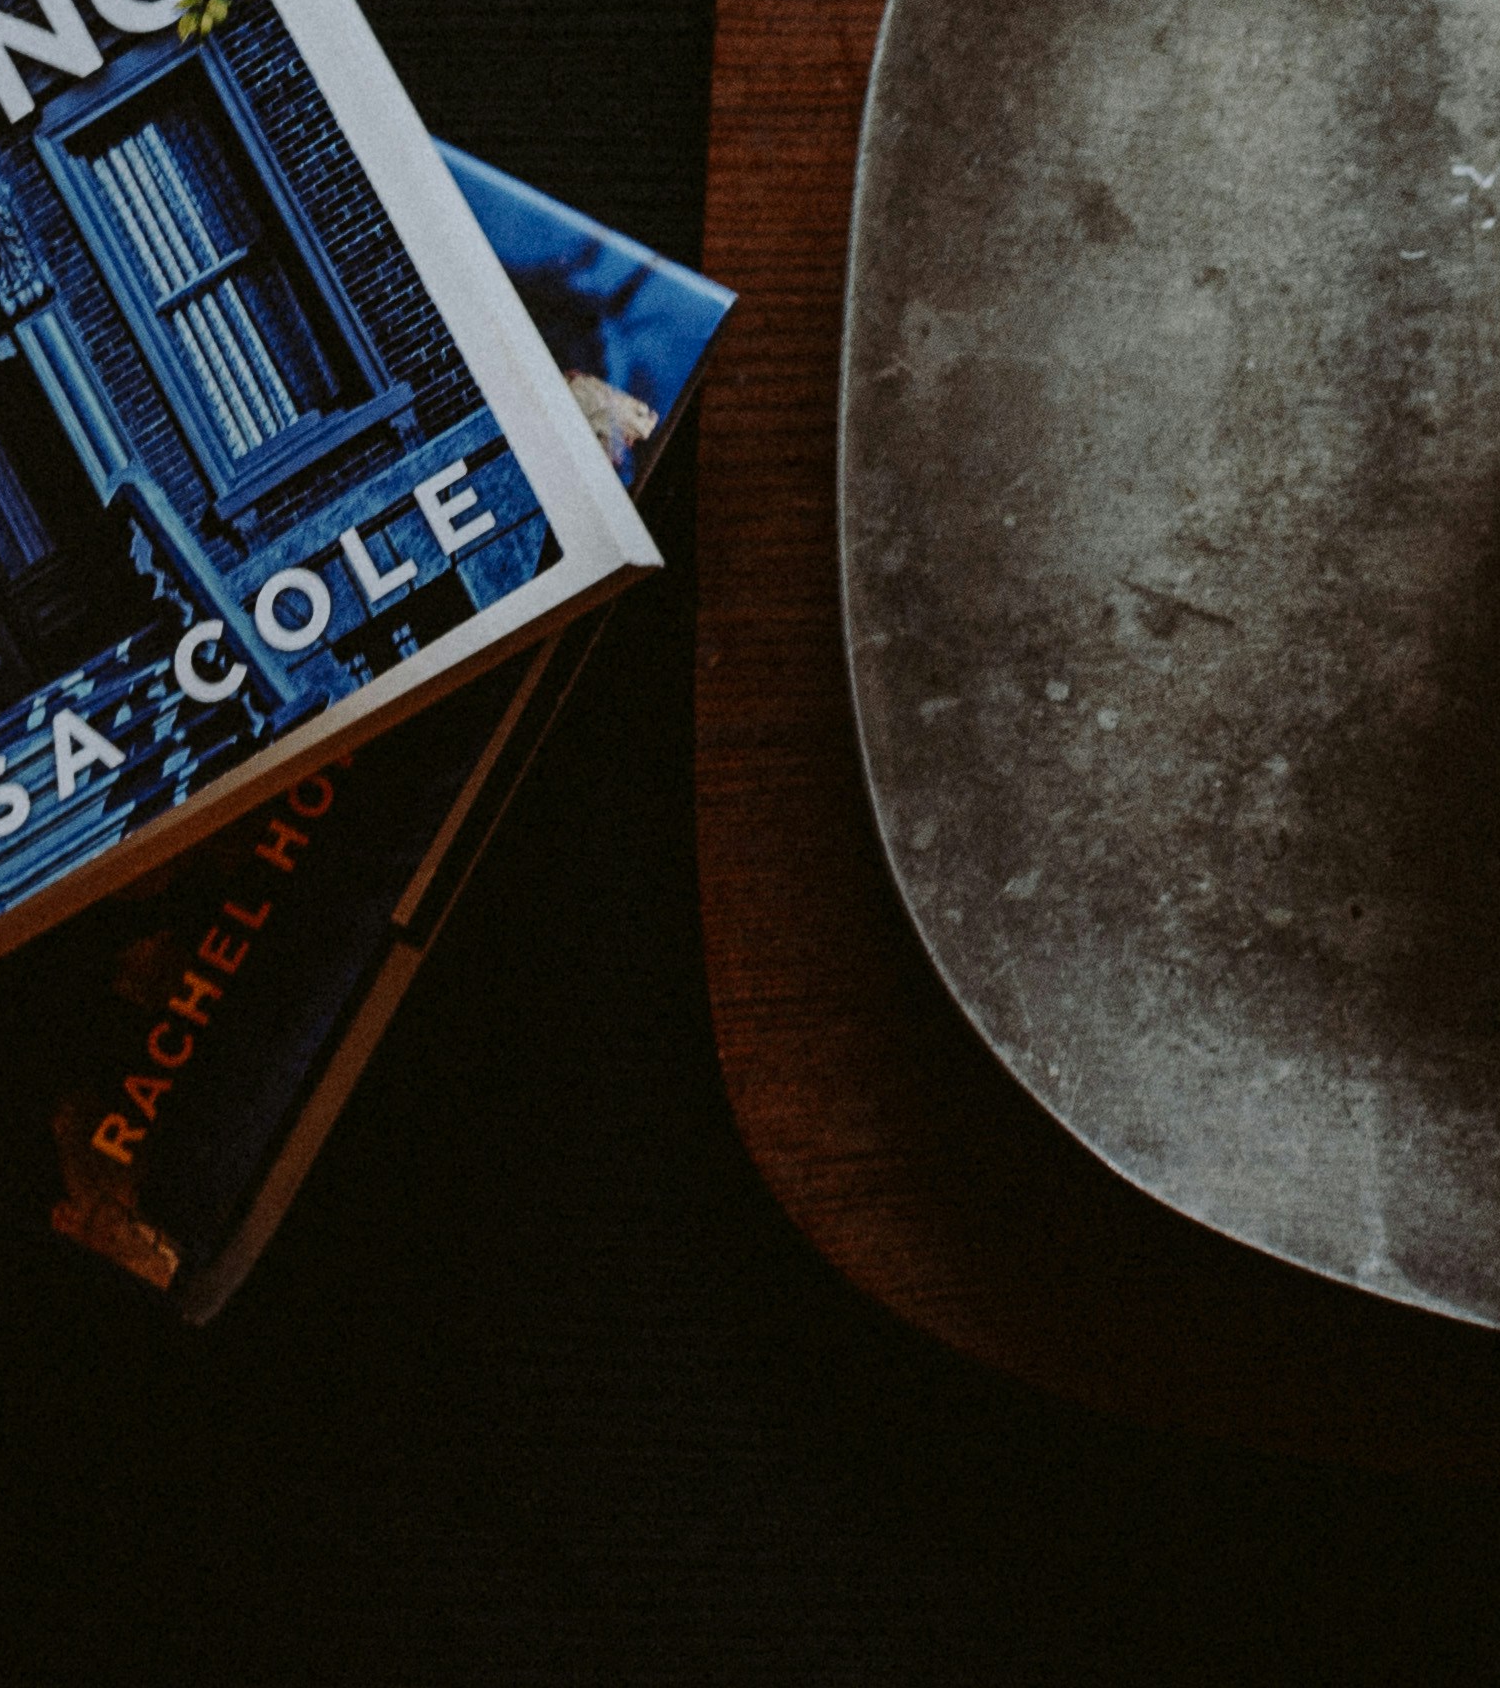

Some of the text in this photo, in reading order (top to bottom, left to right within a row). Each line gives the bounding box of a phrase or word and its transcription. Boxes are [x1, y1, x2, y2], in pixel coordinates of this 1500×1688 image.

[173, 459, 496, 704] COLE
[90, 752, 355, 1166] RACHEL HO
